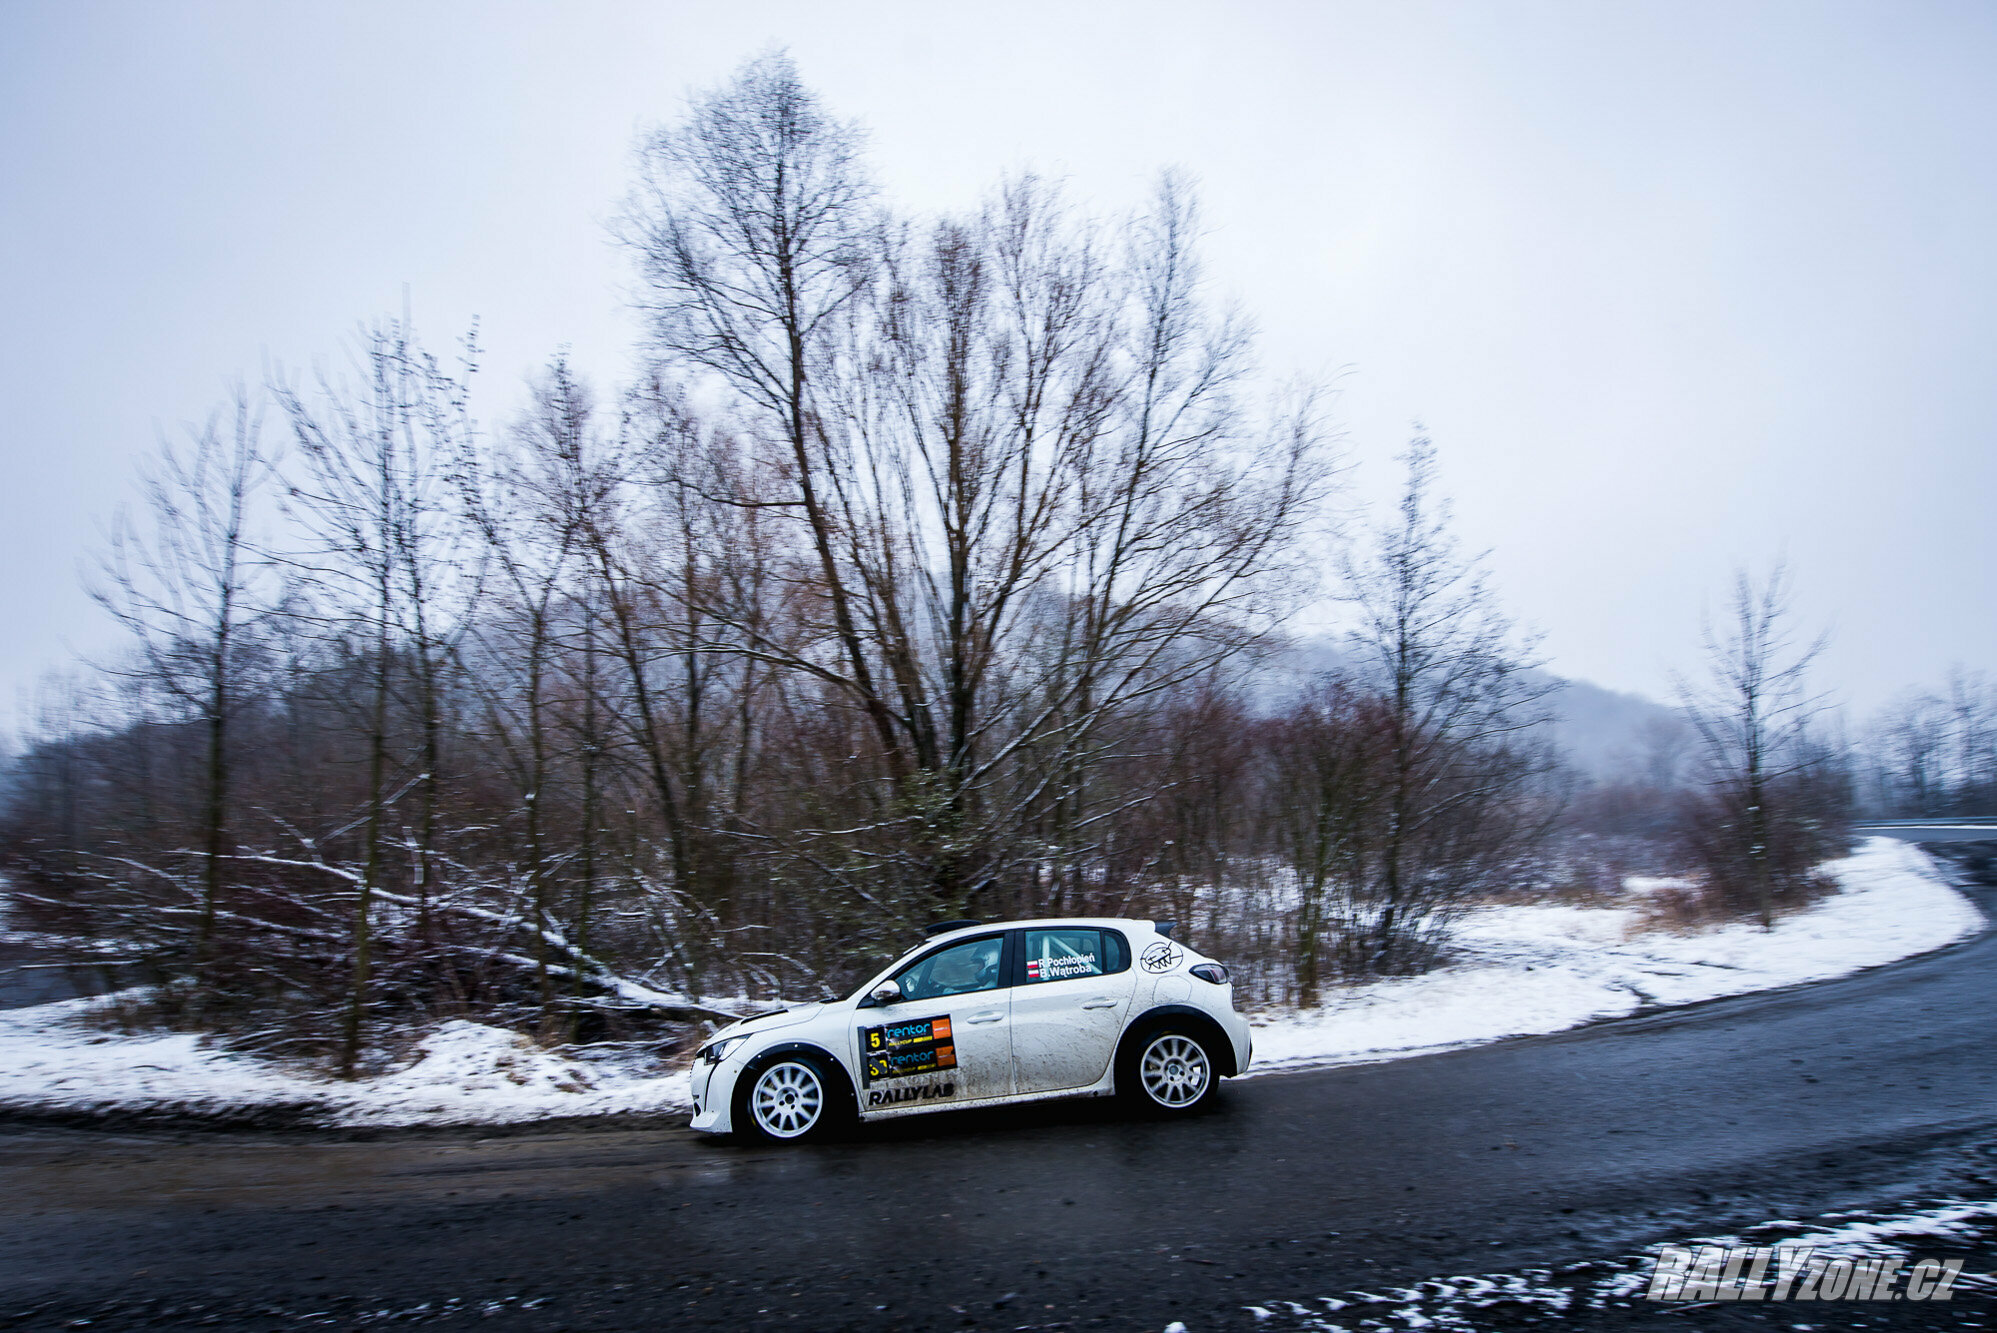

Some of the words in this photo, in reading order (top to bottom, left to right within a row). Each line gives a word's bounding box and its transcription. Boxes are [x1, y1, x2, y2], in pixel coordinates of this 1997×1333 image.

[887, 1023, 931, 1038] rentor
[870, 1033, 881, 1048] 5
[890, 1051, 934, 1066] rentor
